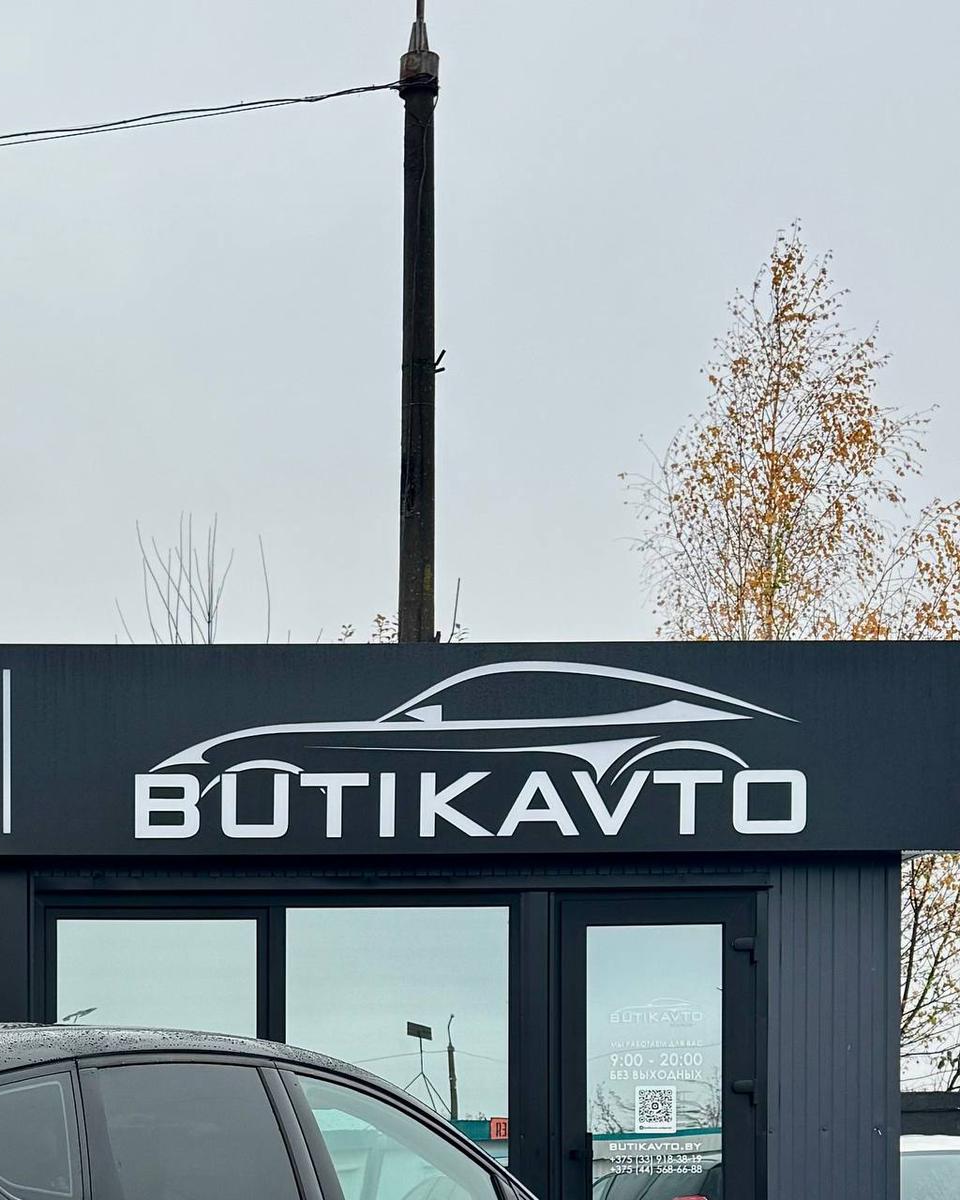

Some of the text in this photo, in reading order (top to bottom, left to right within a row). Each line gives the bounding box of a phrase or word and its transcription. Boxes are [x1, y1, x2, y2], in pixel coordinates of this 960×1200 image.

[133, 768, 808, 839] BUTIKAVTO
[610, 1011, 703, 1023] BUTIKAVTO
[610, 1053, 643, 1067] 9:00
[660, 1053, 703, 1067] 20:00
[610, 1070, 703, 1080] БЕЗ ВЫХОДНЫХ
[609, 1143, 703, 1151] BUTIKAVTO.BY
[610, 1155, 703, 1165] +375 (33) 918-38-19
[610, 1165, 703, 1175] +375 (44) 568-66-88
